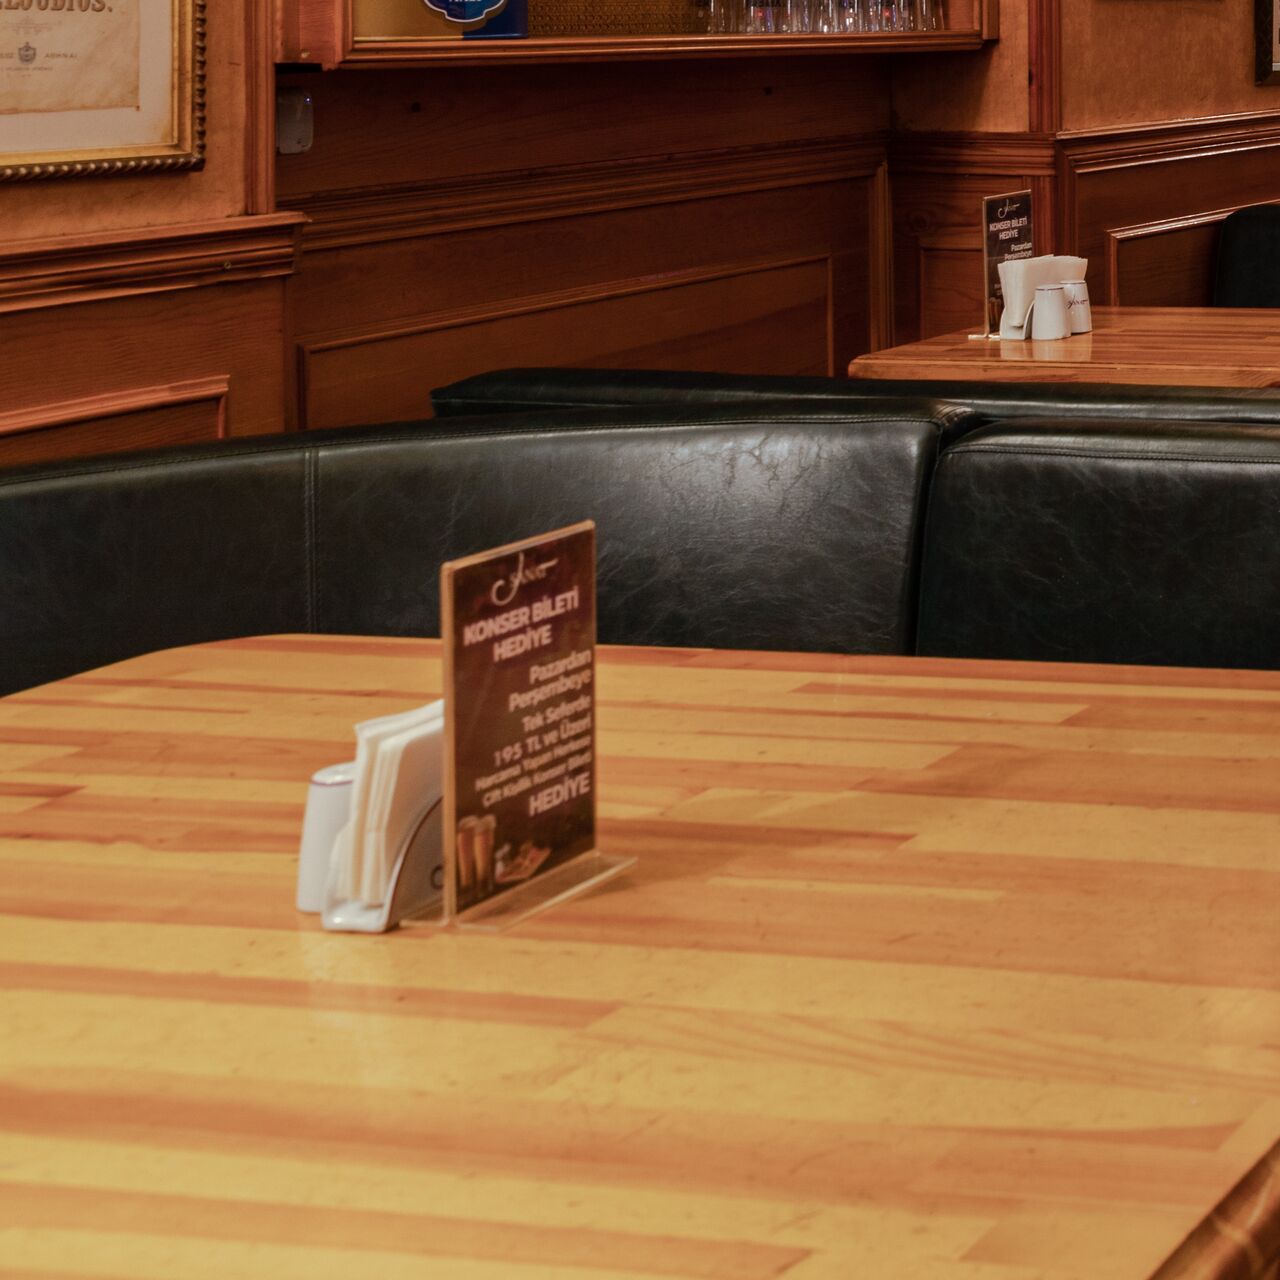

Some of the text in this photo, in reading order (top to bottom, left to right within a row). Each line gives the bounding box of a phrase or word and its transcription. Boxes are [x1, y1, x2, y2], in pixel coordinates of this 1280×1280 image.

[989, 215, 1028, 233] KONSER BİLETİ
[999, 228, 1019, 241] HEDİYE
[464, 585, 580, 648] KONSER BİLETİ
[493, 623, 553, 663] HEDİYE
[529, 649, 592, 685] Pazardan
[509, 668, 592, 713] Perşembeye
[494, 711, 592, 768] 195 TL ve Üzeri
[529, 770, 592, 818] HEDİYE
